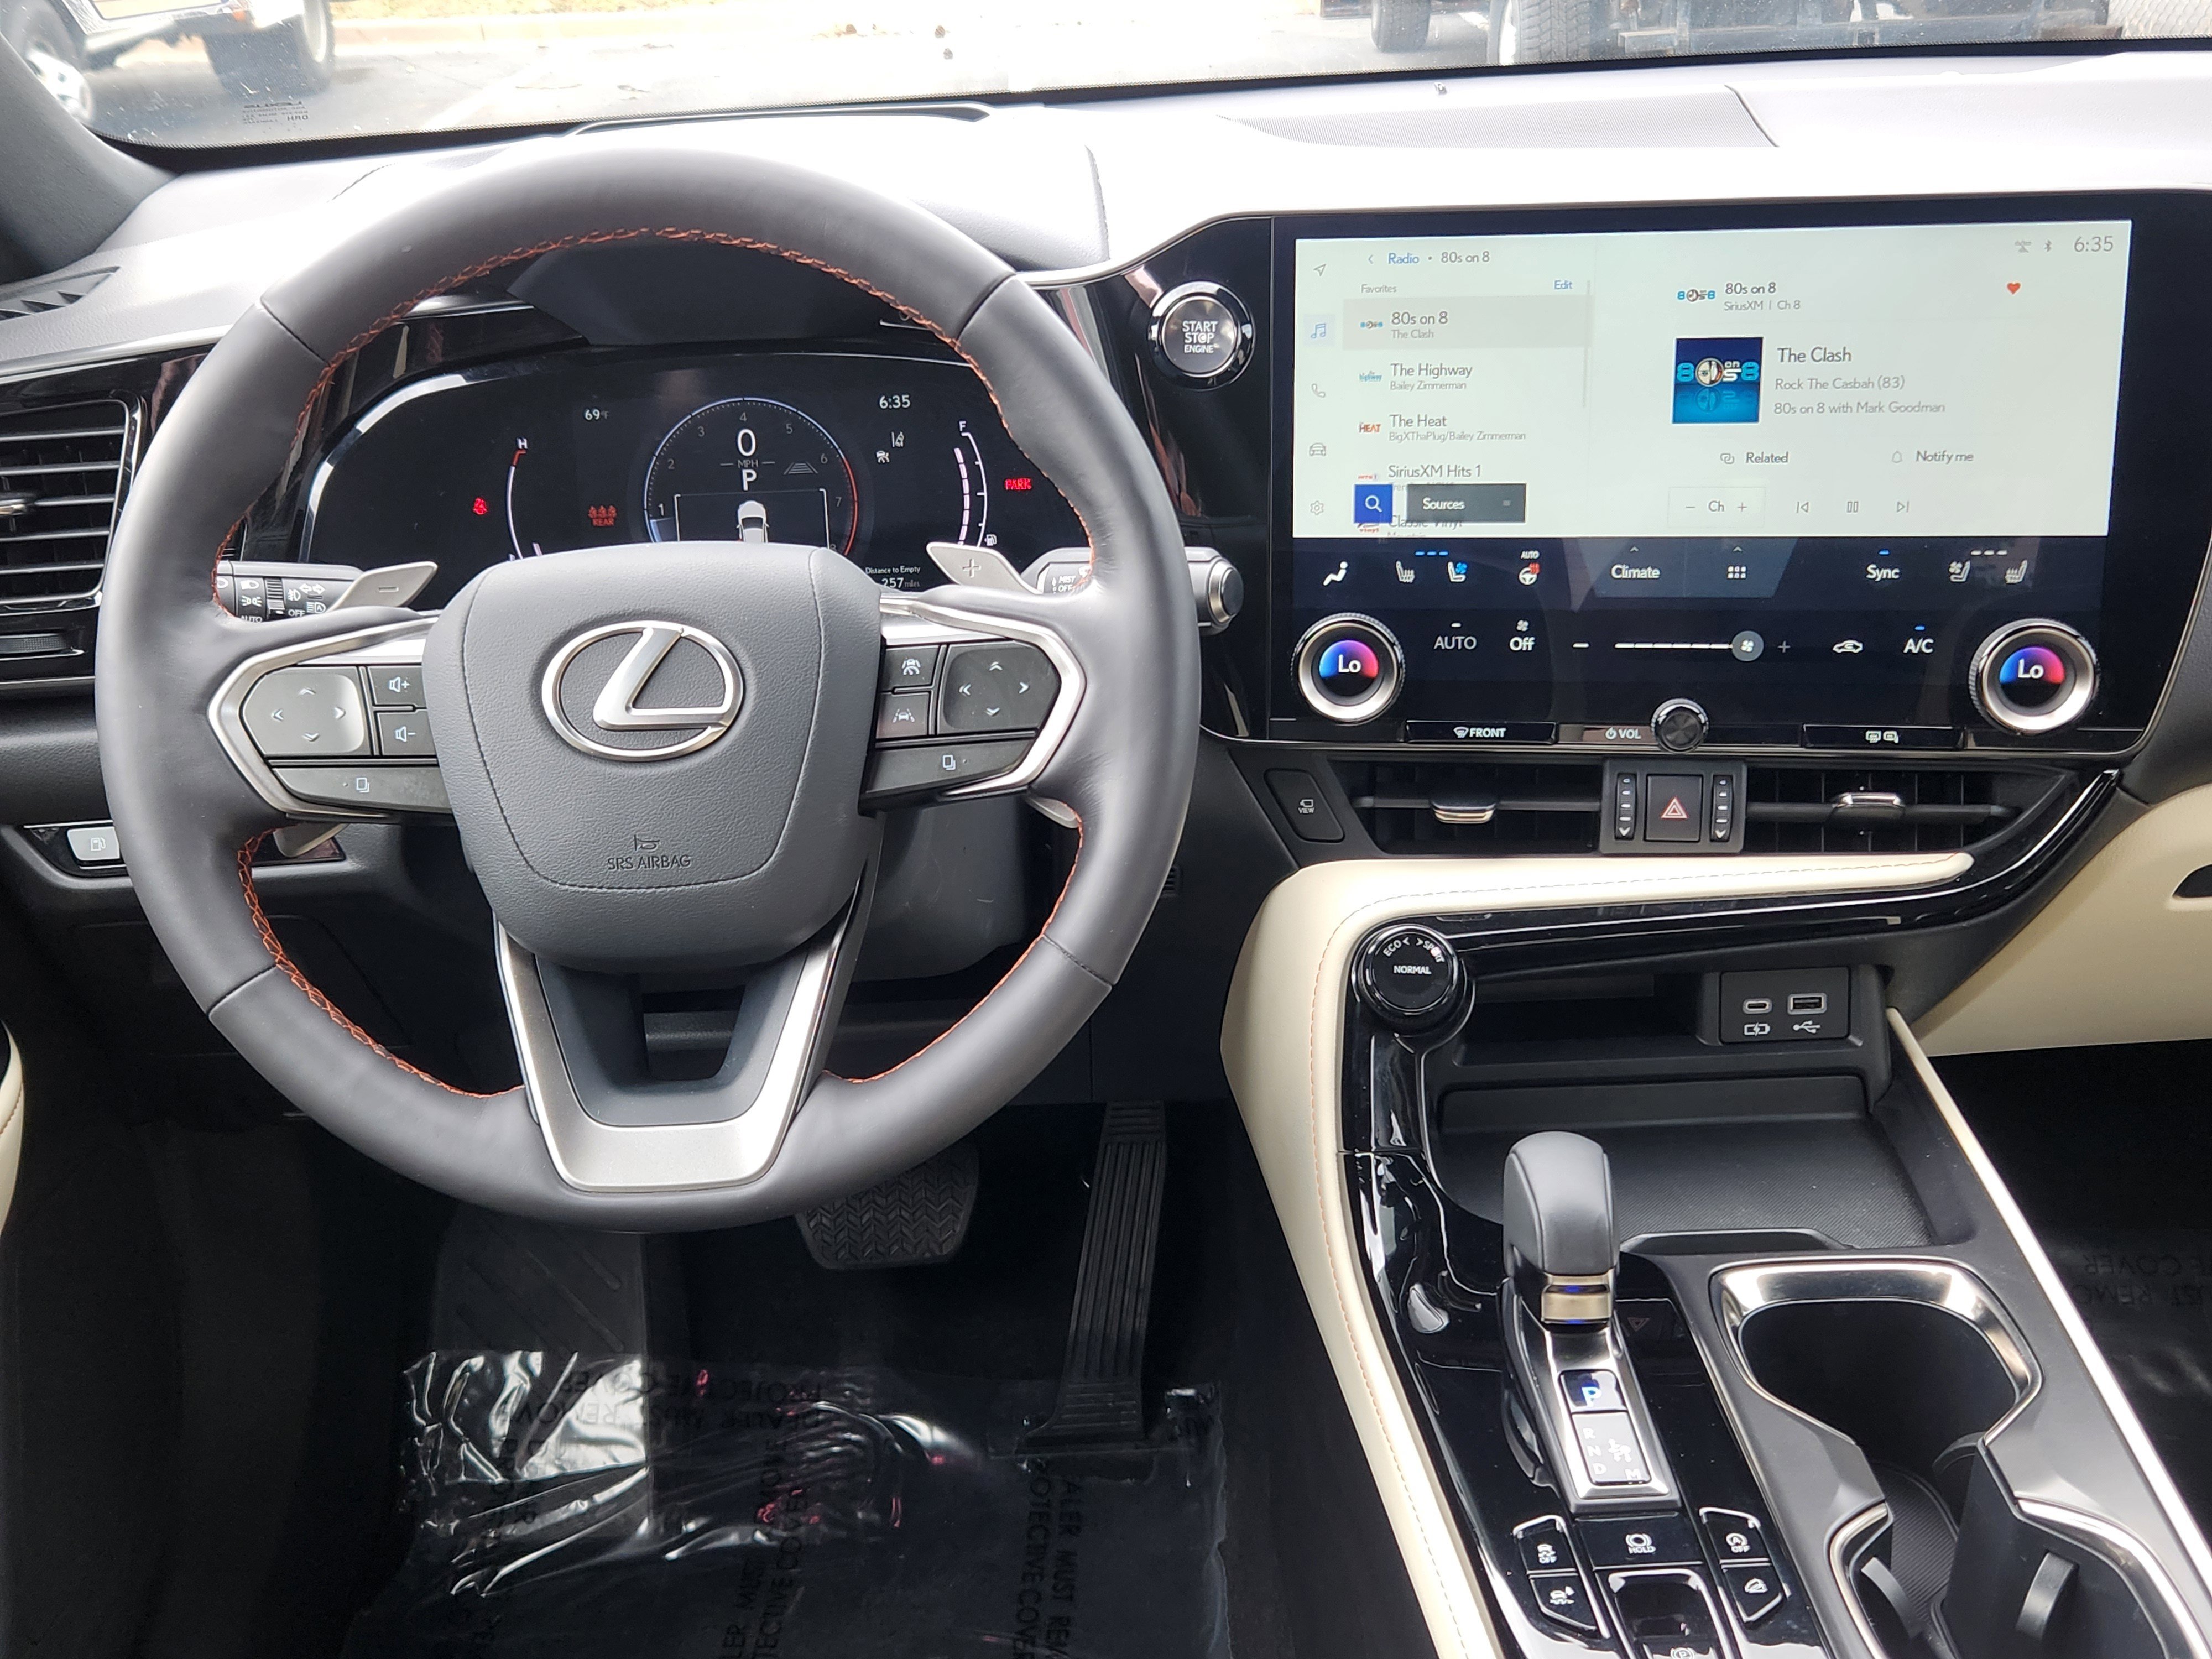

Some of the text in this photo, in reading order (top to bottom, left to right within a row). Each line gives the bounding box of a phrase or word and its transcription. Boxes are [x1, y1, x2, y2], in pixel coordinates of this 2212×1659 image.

[2074, 236, 2113, 252] 6:35
[1388, 251, 1490, 265] Radio 80s on 8
[1361, 284, 1397, 293] Favorites
[1554, 280, 1573, 290] Edit
[1725, 282, 1776, 294] 80s on 8
[1724, 300, 1801, 311] SiriusXM Ch 8
[1391, 311, 1417, 325] 80s
[1420, 316, 1435, 325] on
[1438, 311, 1448, 324] 8
[1182, 320, 1219, 332] START
[1185, 332, 1215, 344] STOP
[1391, 329, 1434, 339] The Clash
[1184, 344, 1214, 354] ENGINE
[1777, 347, 1851, 363] The Clash
[1391, 362, 1473, 379] The Highway
[1390, 380, 1467, 392] Bailey Zimmerman
[1775, 374, 1906, 390] Rock The Casbah (83)
[879, 394, 911, 409] 6:35
[1773, 400, 1945, 415] 80s on 8 with Mark Goodman
[739, 412, 747, 422] 4
[1390, 414, 1447, 427] The Heat
[698, 426, 705, 437] 3
[785, 423, 793, 435] 5
[959, 421, 966, 431] F
[1359, 424, 1381, 433] HEAT
[1477, 431, 1526, 441] Zimmerman
[517, 438, 528, 450] H
[667, 458, 675, 469] 2
[737, 459, 759, 468] MPH
[820, 453, 828, 465] 6
[1745, 451, 1788, 464] Related
[1916, 450, 1974, 465] Notify me
[1388, 463, 1481, 478] SiriusXM Hits 1
[741, 469, 757, 491] P
[1004, 478, 1032, 489] PARK
[835, 497, 842, 507] 7
[1422, 497, 1466, 510] Sources
[1708, 500, 1725, 513] Ch
[658, 503, 665, 516] 1
[1521, 550, 1540, 559] AUTO
[865, 566, 891, 575] Distance
[900, 565, 921, 574] Empty
[1611, 564, 1661, 580] Climate
[1866, 563, 1900, 581] Sync
[881, 577, 904, 588] 257
[288, 609, 306, 617] OFF
[1434, 635, 1478, 651] AUTO
[1509, 635, 1536, 652] Off
[1903, 638, 1934, 655] A/C
[1338, 654, 1361, 674] Lo
[2017, 658, 2044, 680] Lo
[1469, 727, 1507, 738] FRONT
[1618, 728, 1642, 740] VOL
[607, 854, 692, 870] SRS AIRBAG
[1383, 940, 1402, 957] ECO
[1393, 965, 1432, 975] NORMAL
[1581, 1385, 1603, 1407] P
[1582, 1427, 1595, 1440] R
[1588, 1444, 1603, 1458] N
[1593, 1462, 1607, 1475] D
[1625, 1468, 1641, 1481] M
[1629, 1545, 1657, 1554] HOLD
[1730, 1544, 1751, 1553] OFF
[1538, 1556, 1558, 1564] OFF
